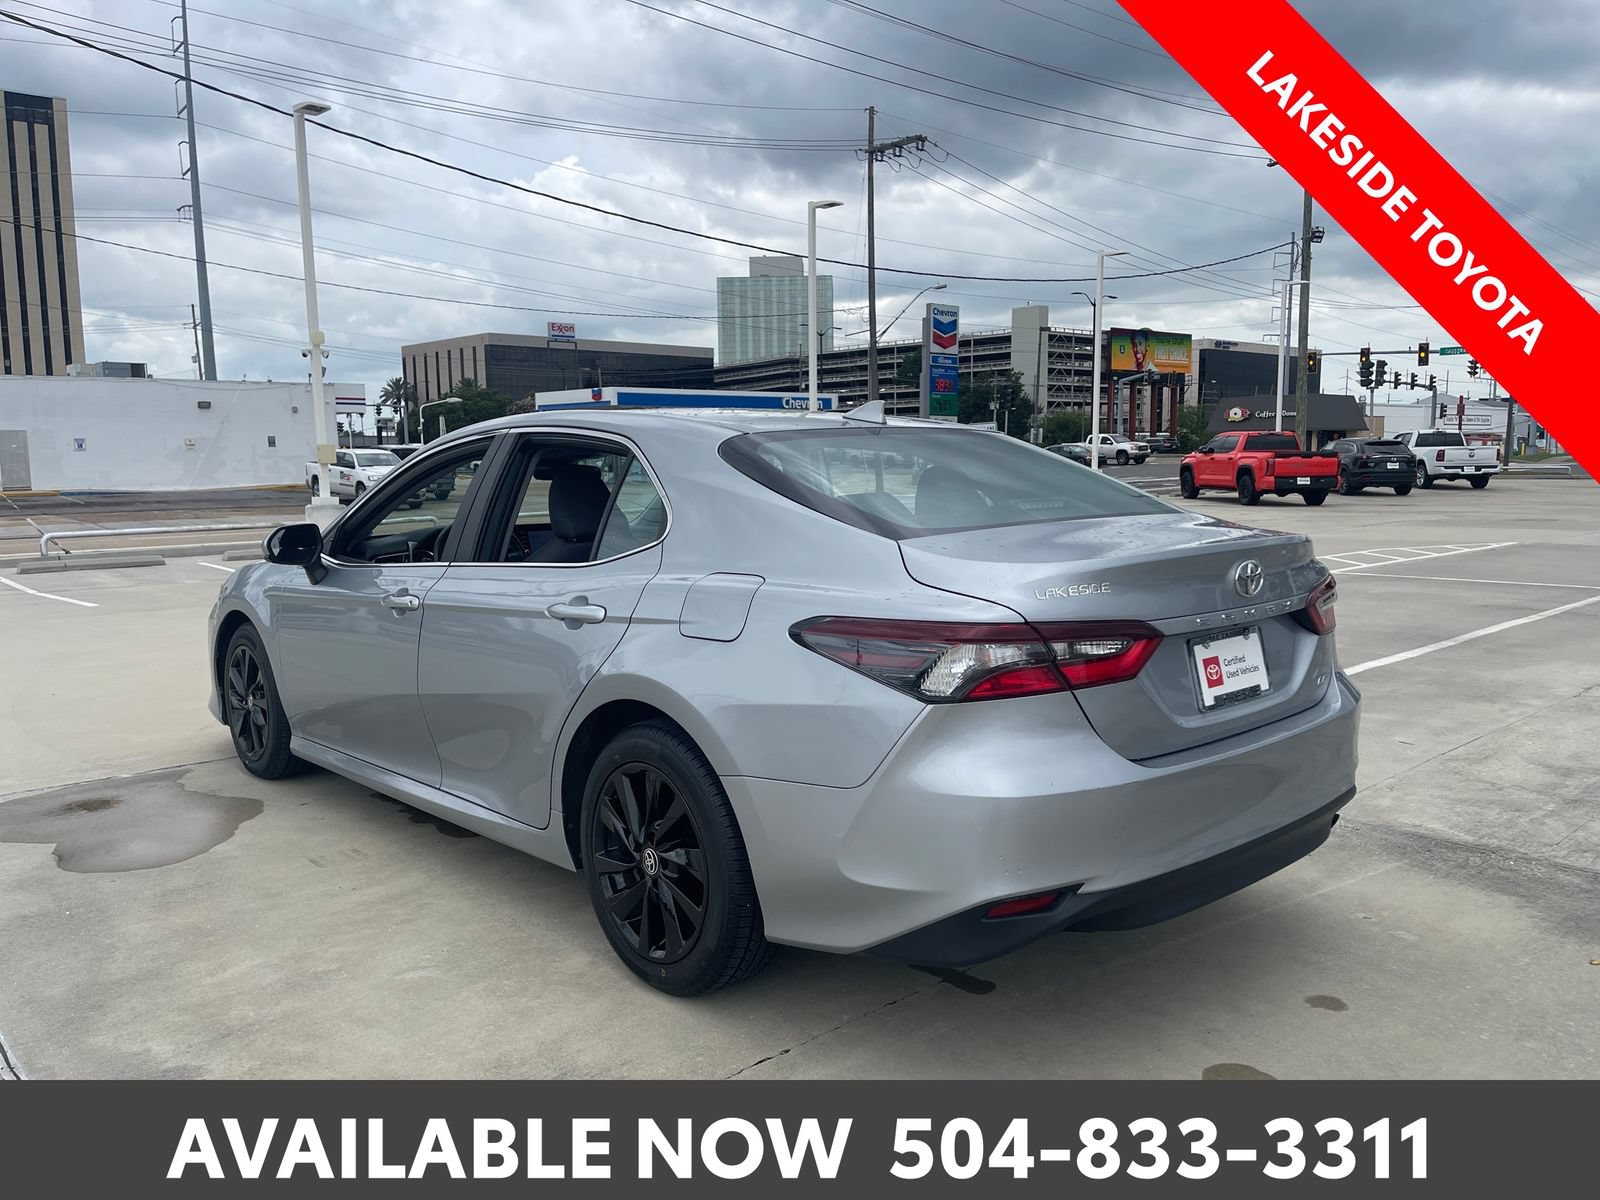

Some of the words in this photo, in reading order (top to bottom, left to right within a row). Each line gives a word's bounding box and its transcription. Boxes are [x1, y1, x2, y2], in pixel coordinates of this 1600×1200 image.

[932, 307, 958, 317] Chevron
[551, 323, 575, 335] Exxon
[782, 397, 824, 409] Chevrn
[1255, 410, 1275, 418] Coffee
[1034, 582, 1111, 600] LAKESIDE
[1223, 653, 1246, 667] Certified
[1226, 669, 1240, 679] Used
[1239, 664, 1260, 676] Vehicles
